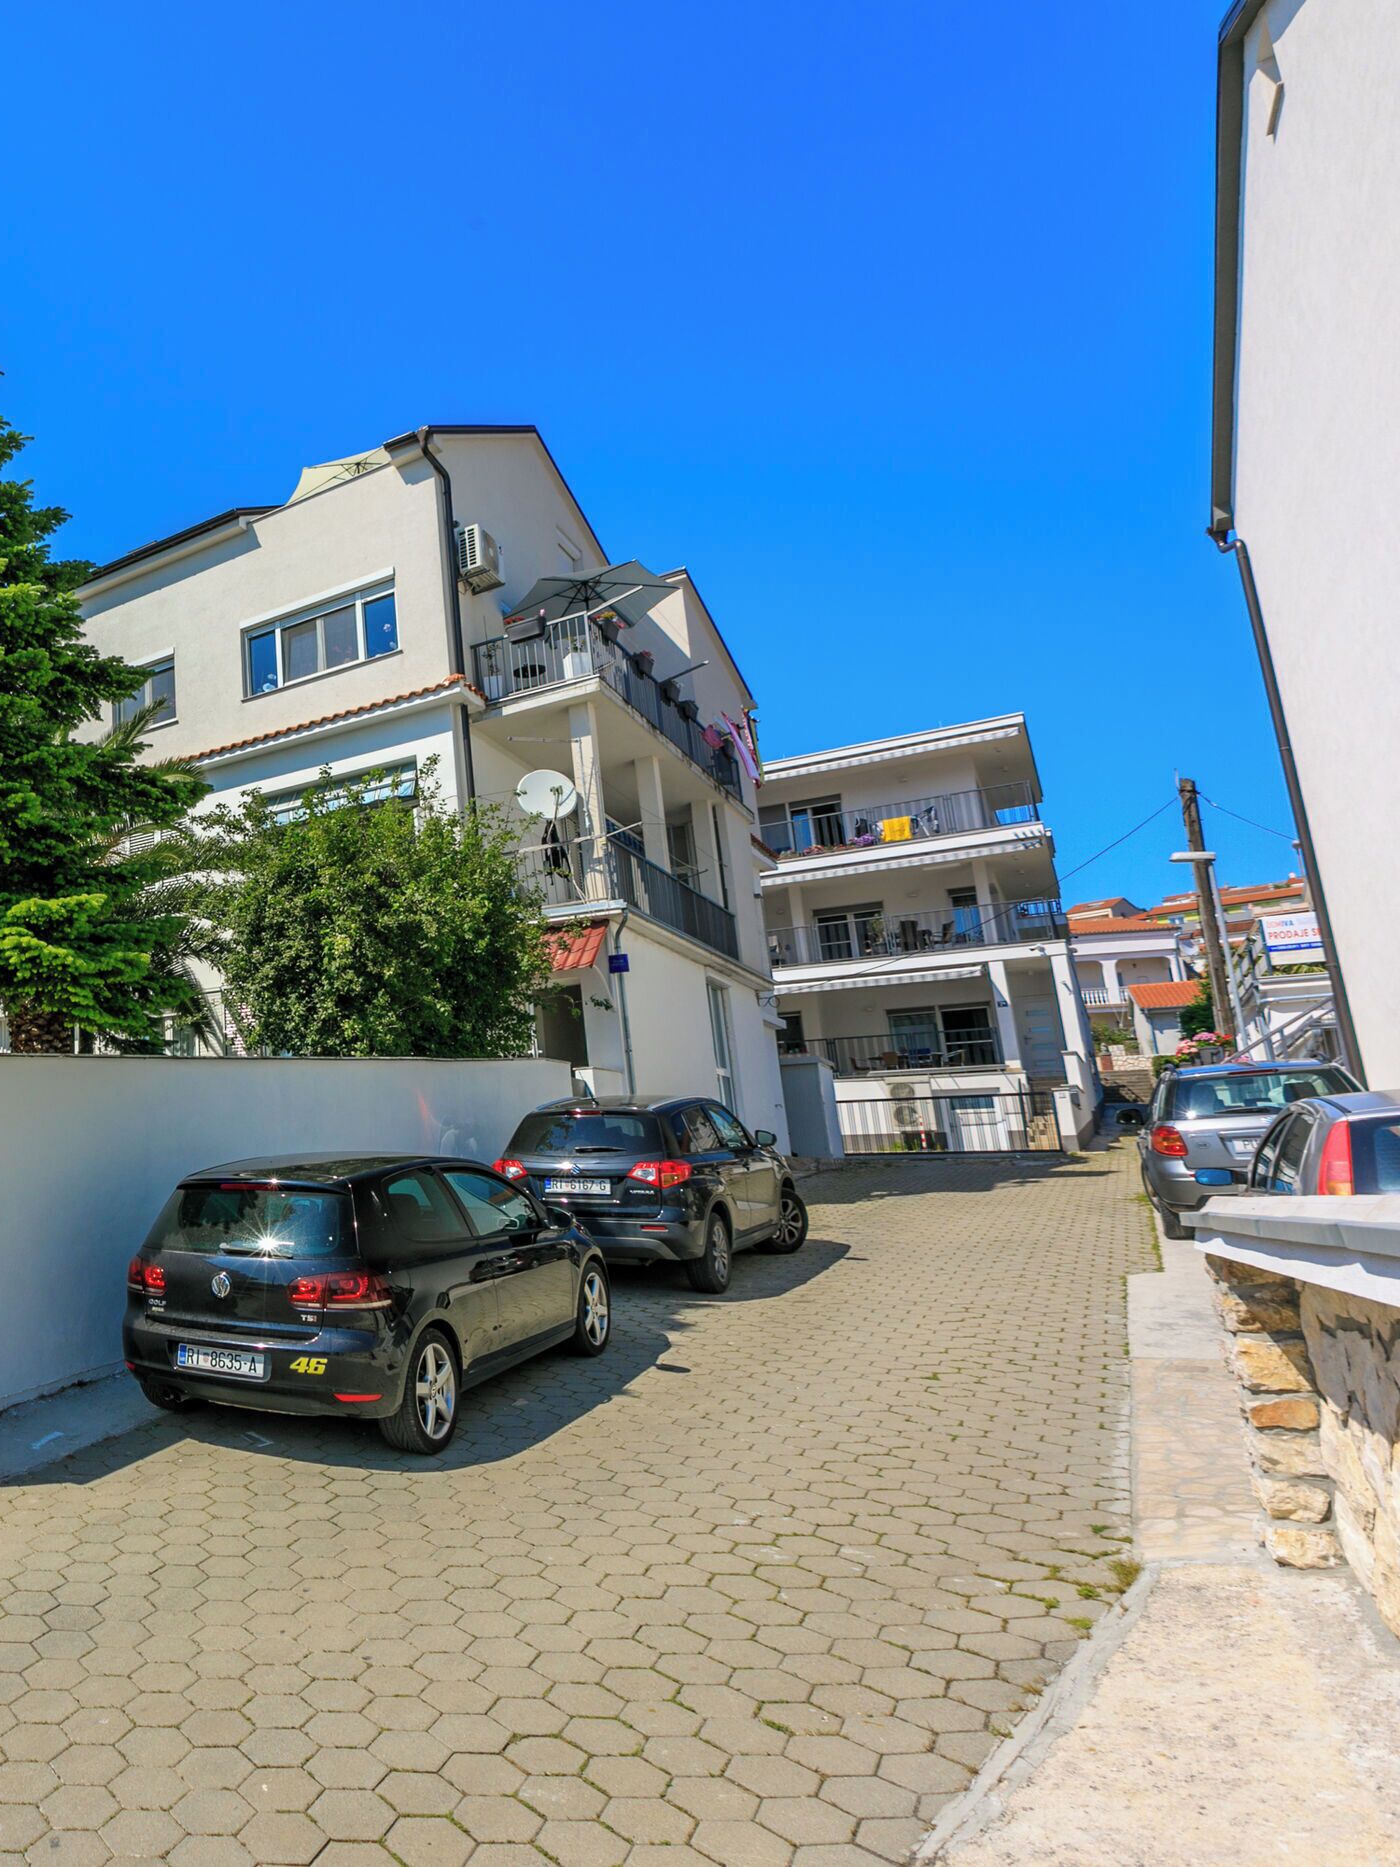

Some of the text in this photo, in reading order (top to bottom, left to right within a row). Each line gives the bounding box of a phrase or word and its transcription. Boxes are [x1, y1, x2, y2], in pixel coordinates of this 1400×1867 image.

[1268, 928, 1309, 940] PRODAJE
[552, 1179, 563, 1190] RI
[148, 1298, 167, 1306] GOLF
[187, 1348, 257, 1373] RI 8635-A
[289, 1356, 328, 1375] 46
